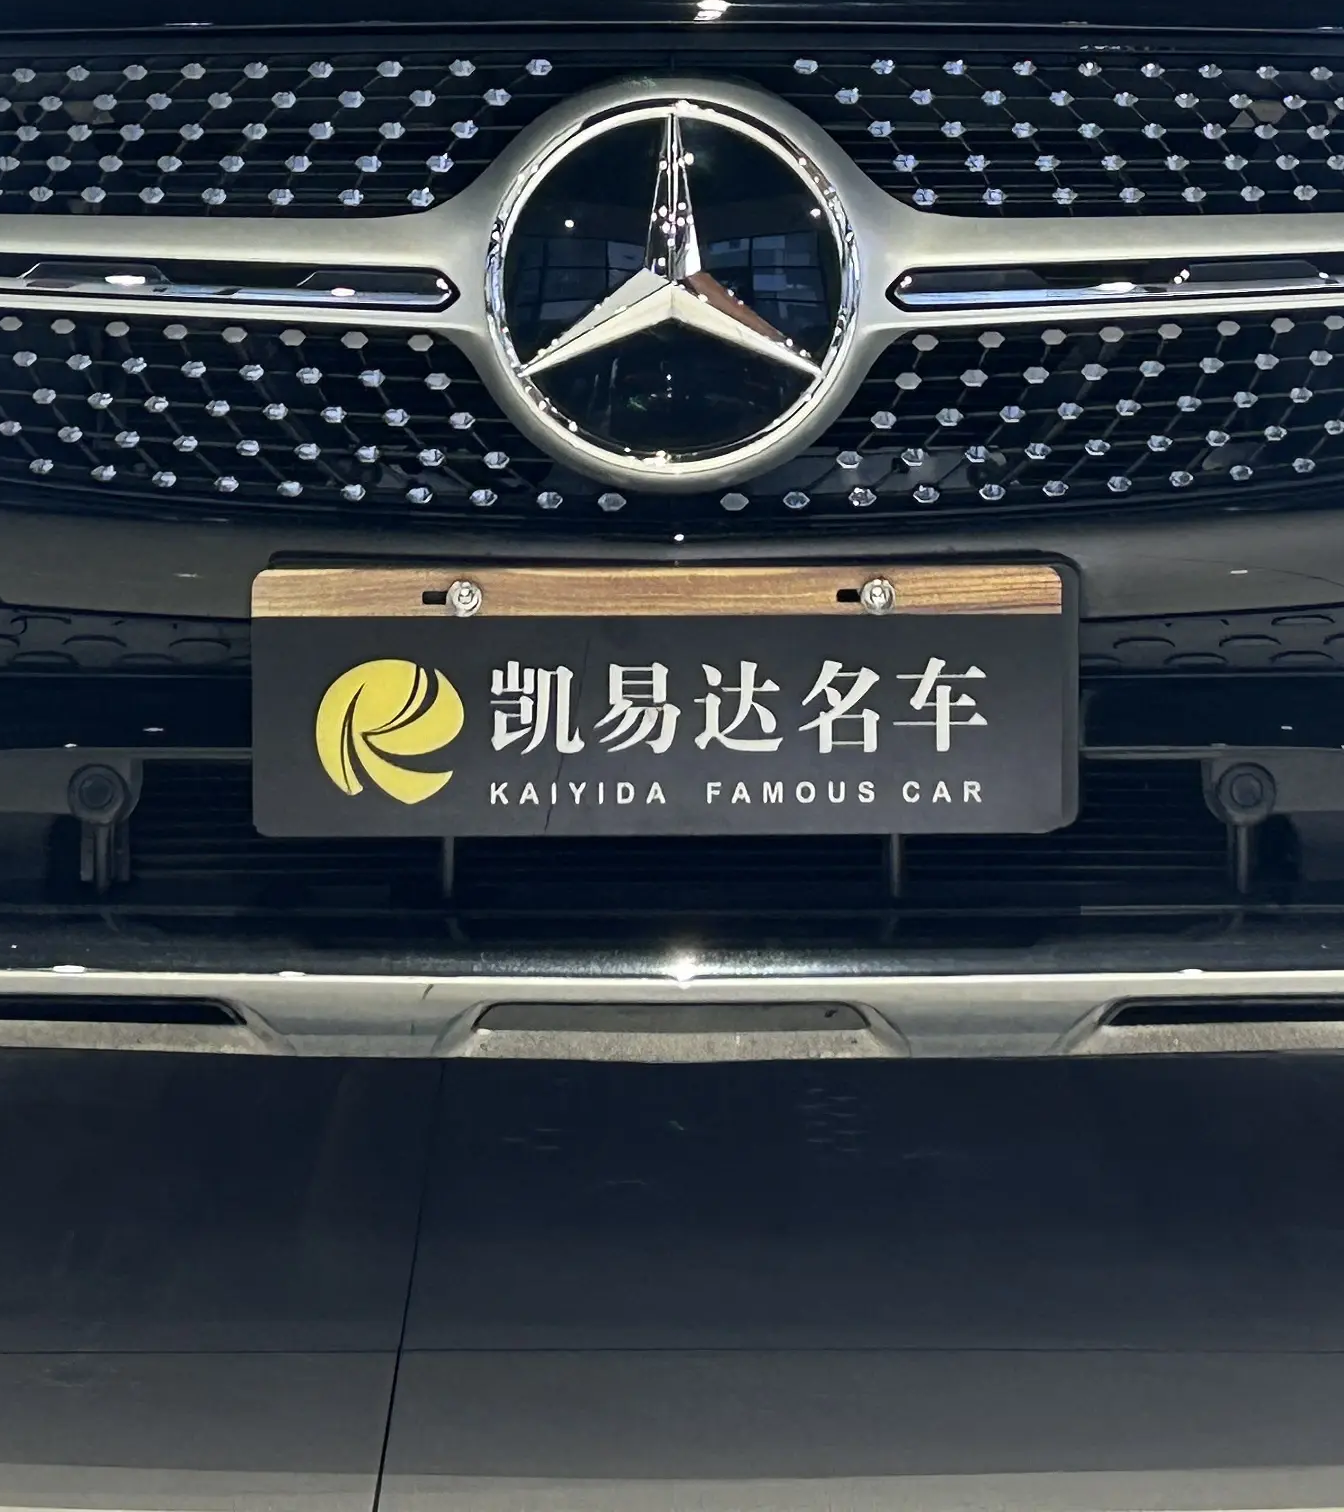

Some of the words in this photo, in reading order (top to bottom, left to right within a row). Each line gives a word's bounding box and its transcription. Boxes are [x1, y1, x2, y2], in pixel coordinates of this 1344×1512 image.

[489, 657, 989, 756] 凯易达名车
[490, 780, 667, 805] KAIYIDA
[706, 780, 876, 805] FAMOUS
[902, 780, 984, 805] CAR
